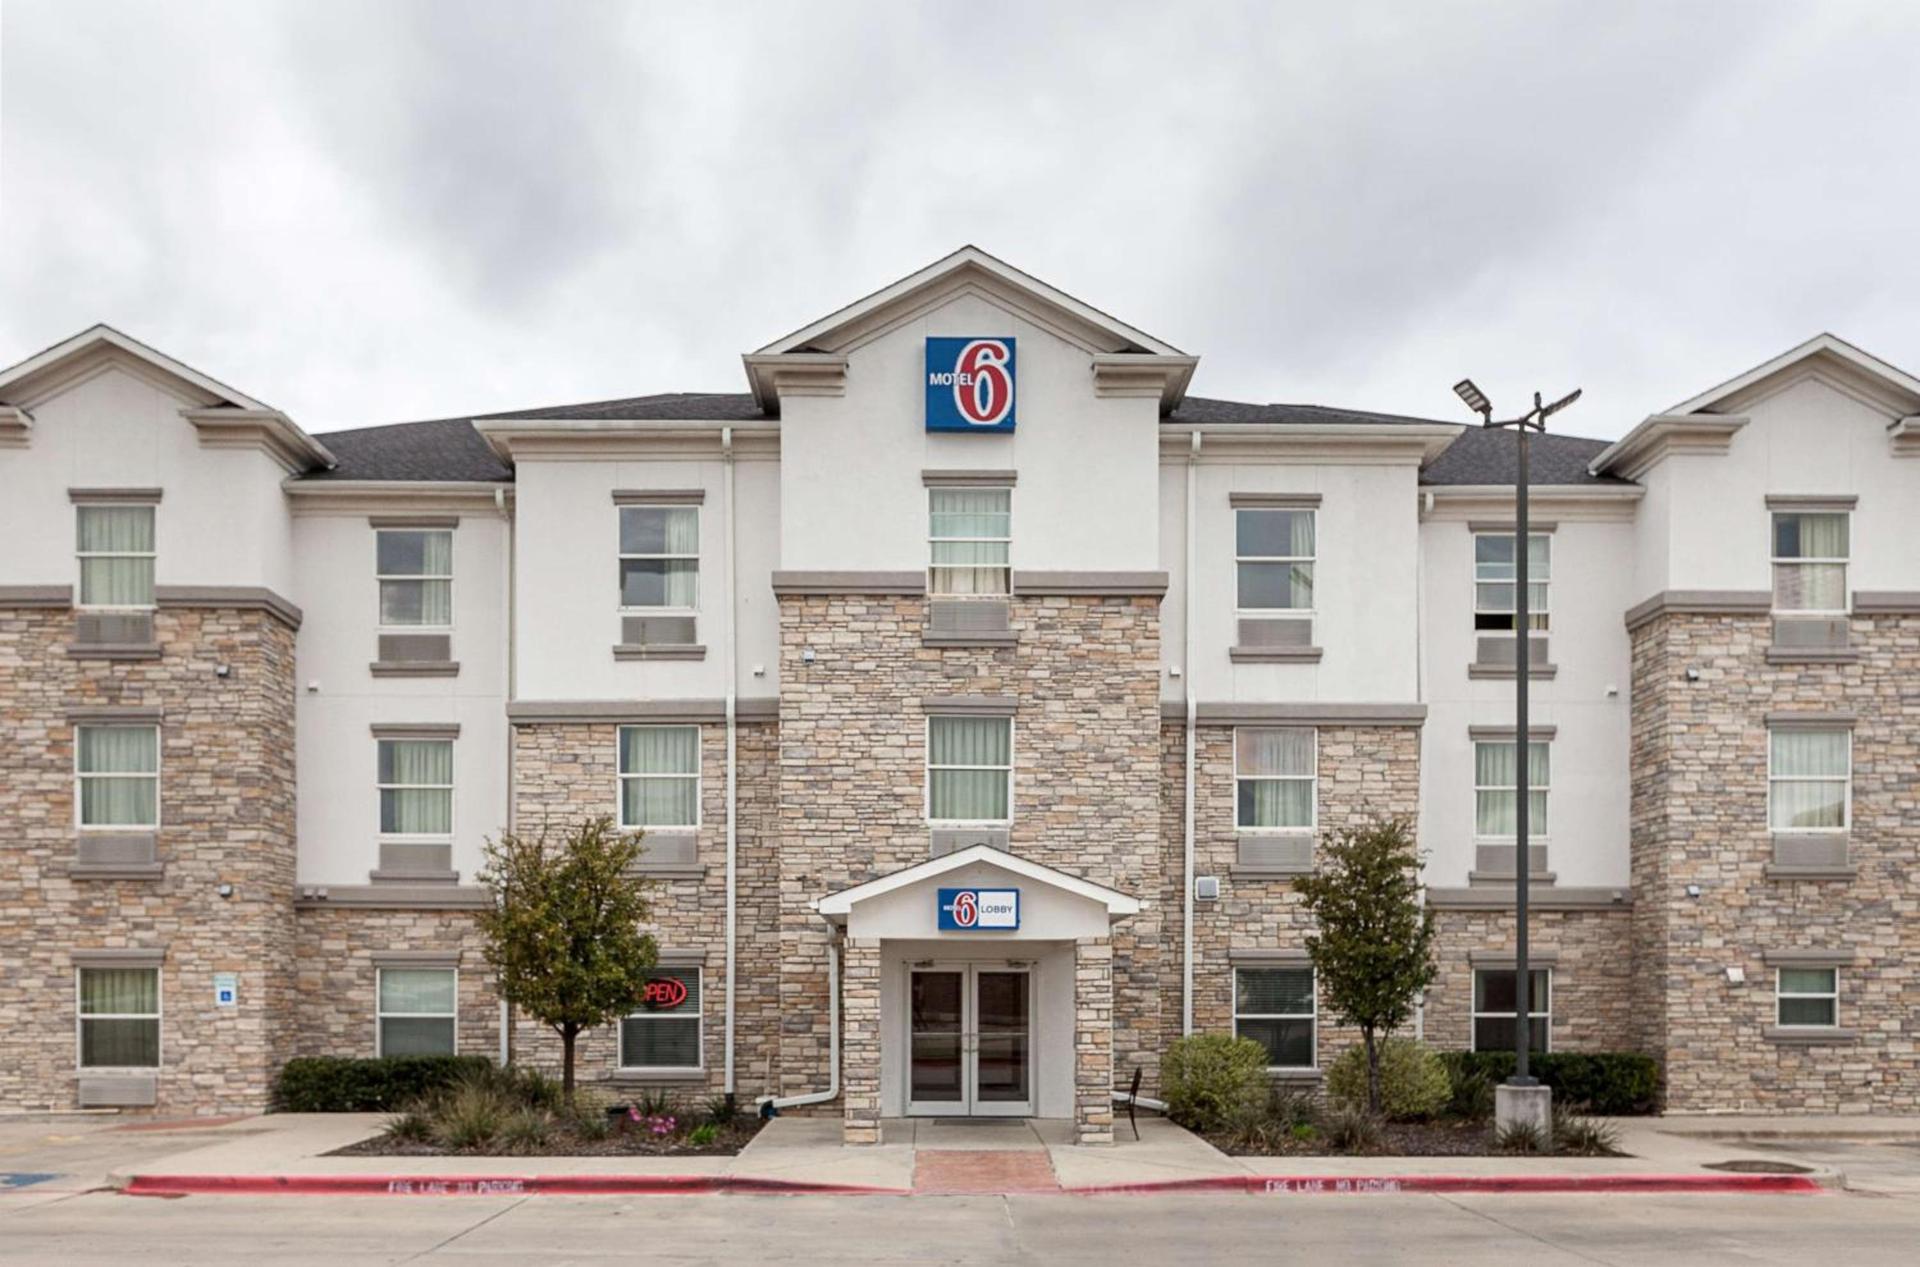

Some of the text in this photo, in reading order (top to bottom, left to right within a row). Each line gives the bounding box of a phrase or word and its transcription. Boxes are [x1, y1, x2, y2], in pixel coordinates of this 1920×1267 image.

[929, 339, 1013, 425] MOTEL 6
[953, 891, 977, 927] 6
[981, 905, 1013, 914] LOBBY
[640, 983, 678, 1002] PEN
